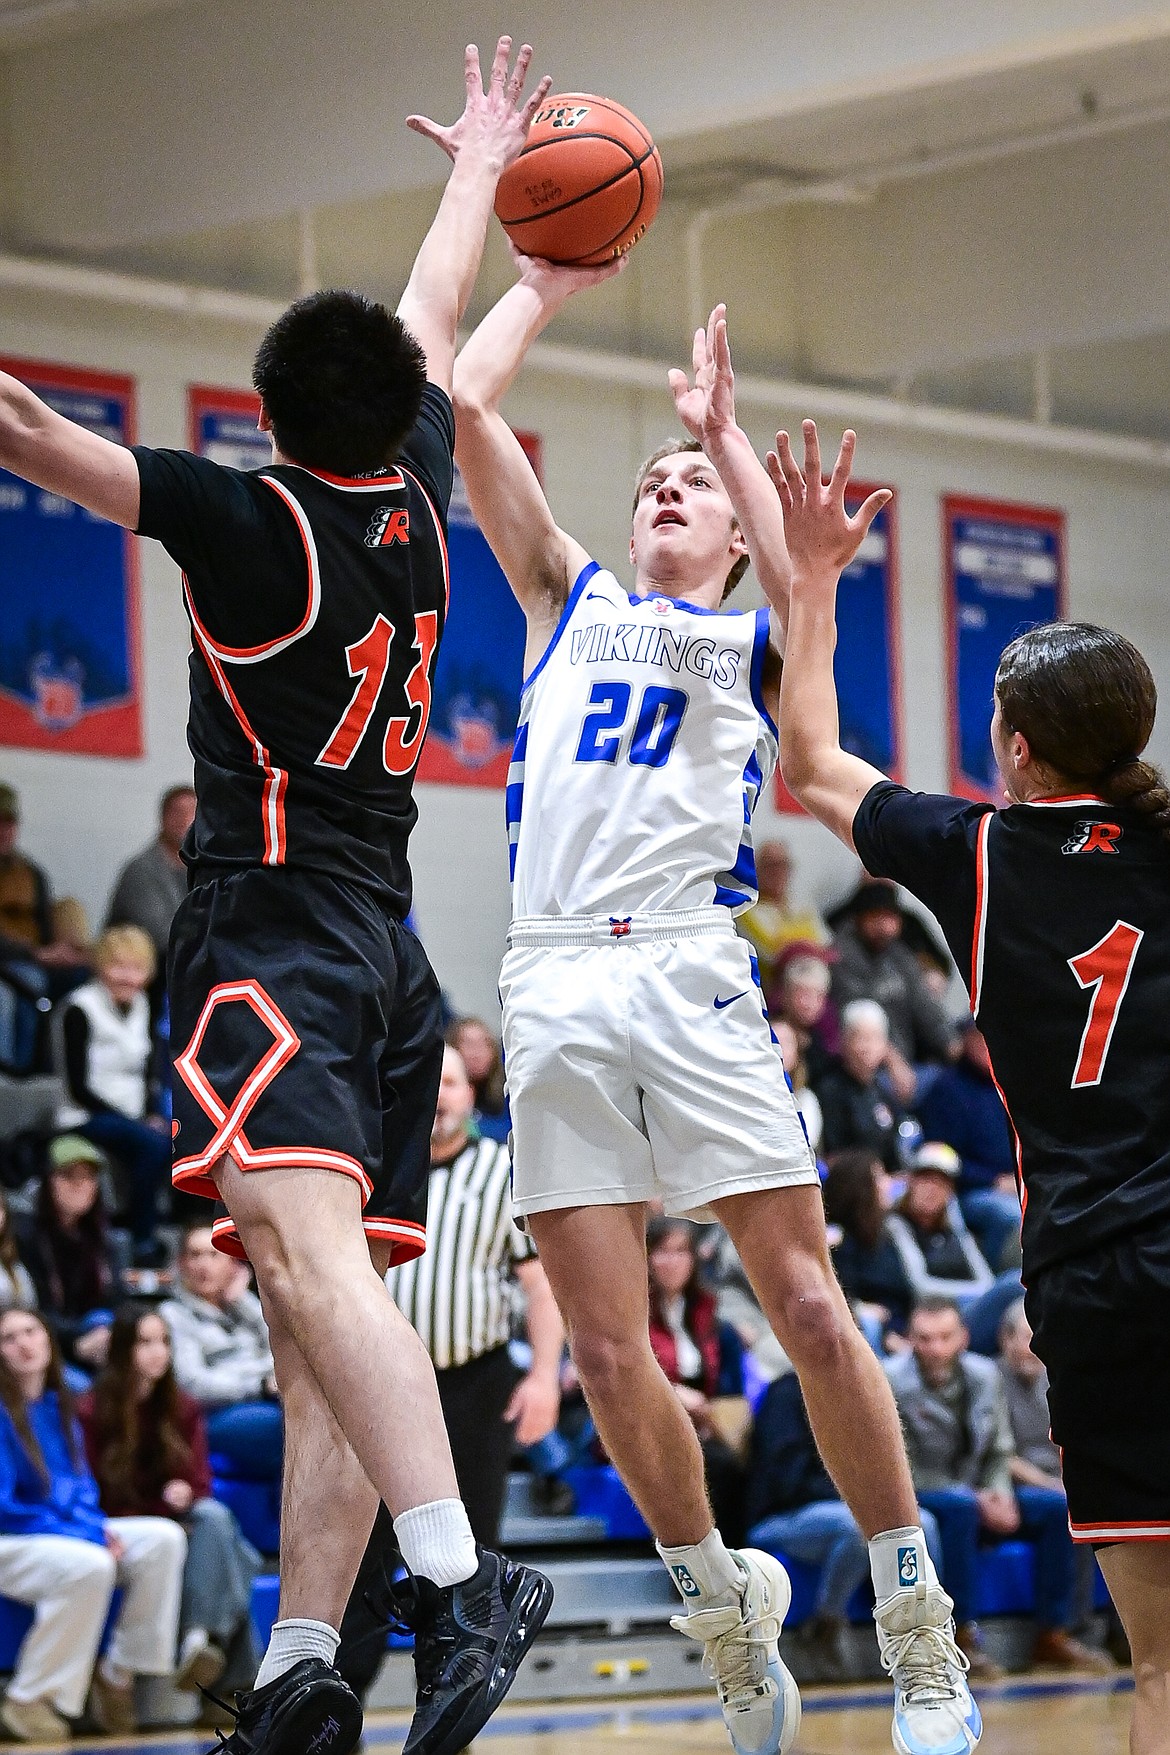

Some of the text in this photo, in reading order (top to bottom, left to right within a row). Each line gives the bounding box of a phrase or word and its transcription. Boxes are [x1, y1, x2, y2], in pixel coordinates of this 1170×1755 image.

[314, 610, 438, 776] 13
[570, 623, 742, 690] VIKINGS
[572, 679, 690, 770] 20
[1066, 919, 1145, 1089] 1
